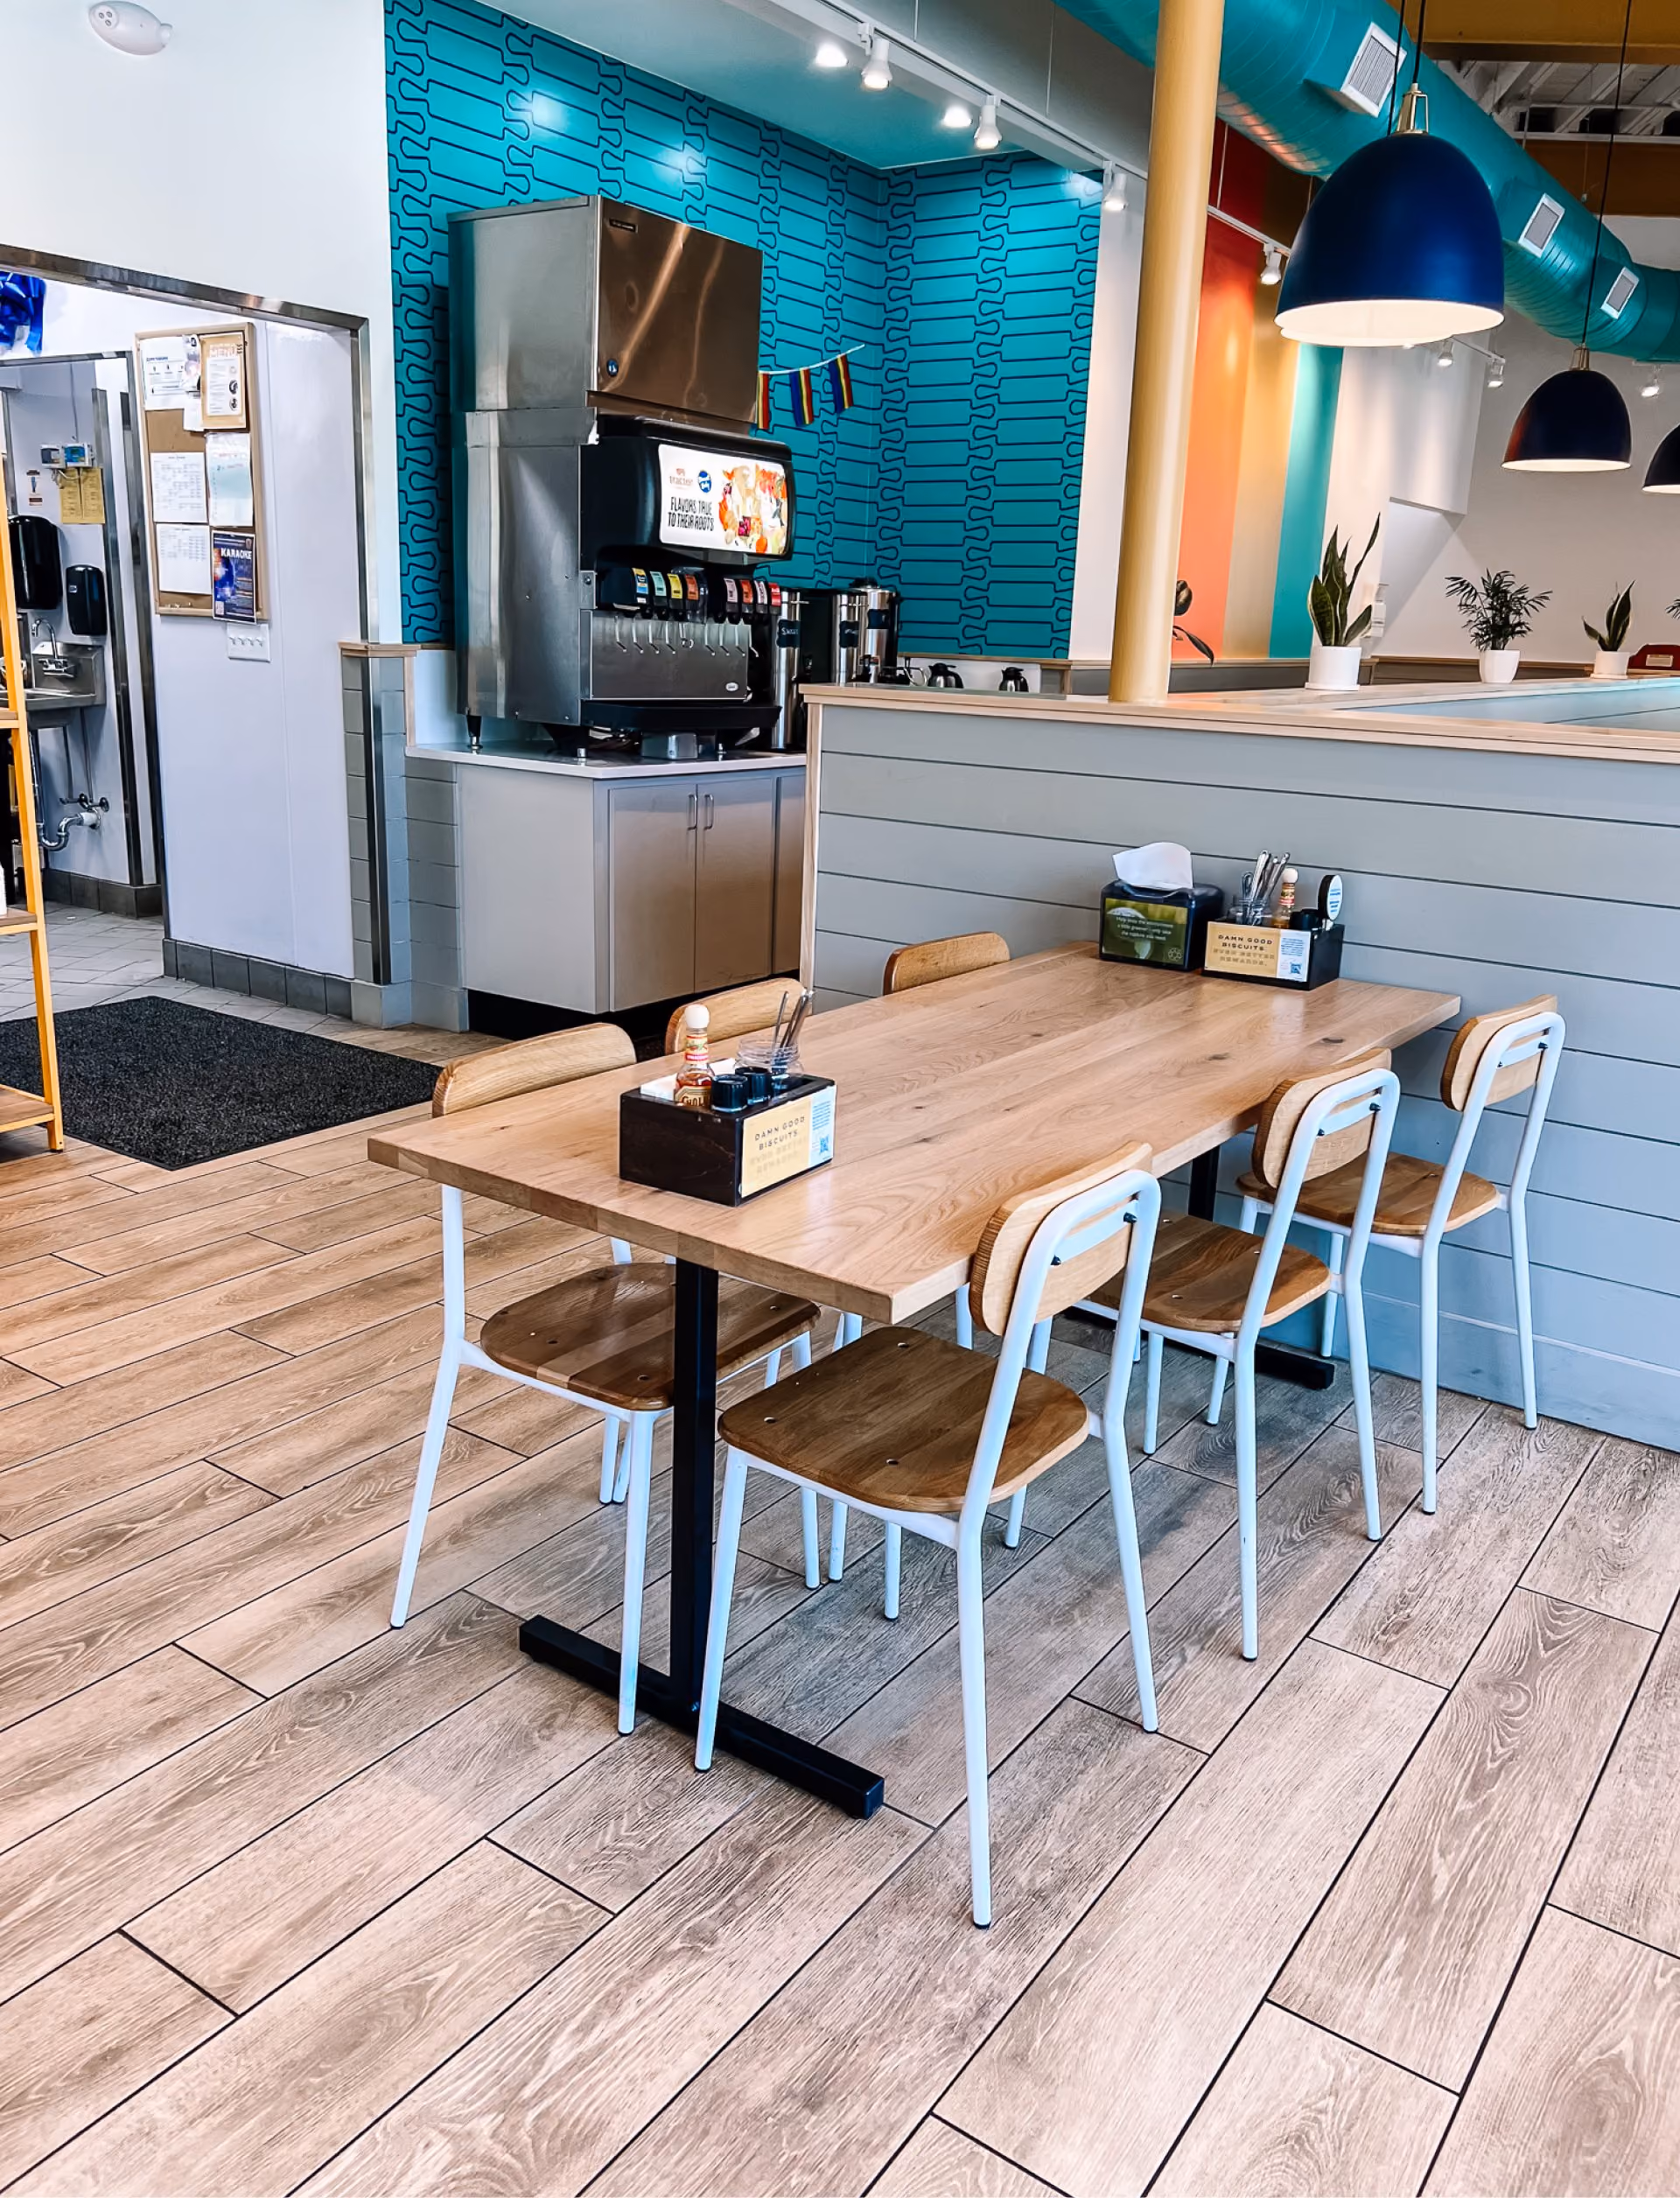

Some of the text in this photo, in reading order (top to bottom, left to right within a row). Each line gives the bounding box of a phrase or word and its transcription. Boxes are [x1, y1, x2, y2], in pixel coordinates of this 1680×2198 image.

[670, 496, 713, 516] FLAVORS TRUE
[668, 512, 715, 532] TO THEIR ROOTS
[220, 547, 253, 560] KARAOKE
[1239, 951, 1275, 960] BETTER
[754, 1126, 780, 1141] DAMN
[782, 1116, 805, 1130] GOOD
